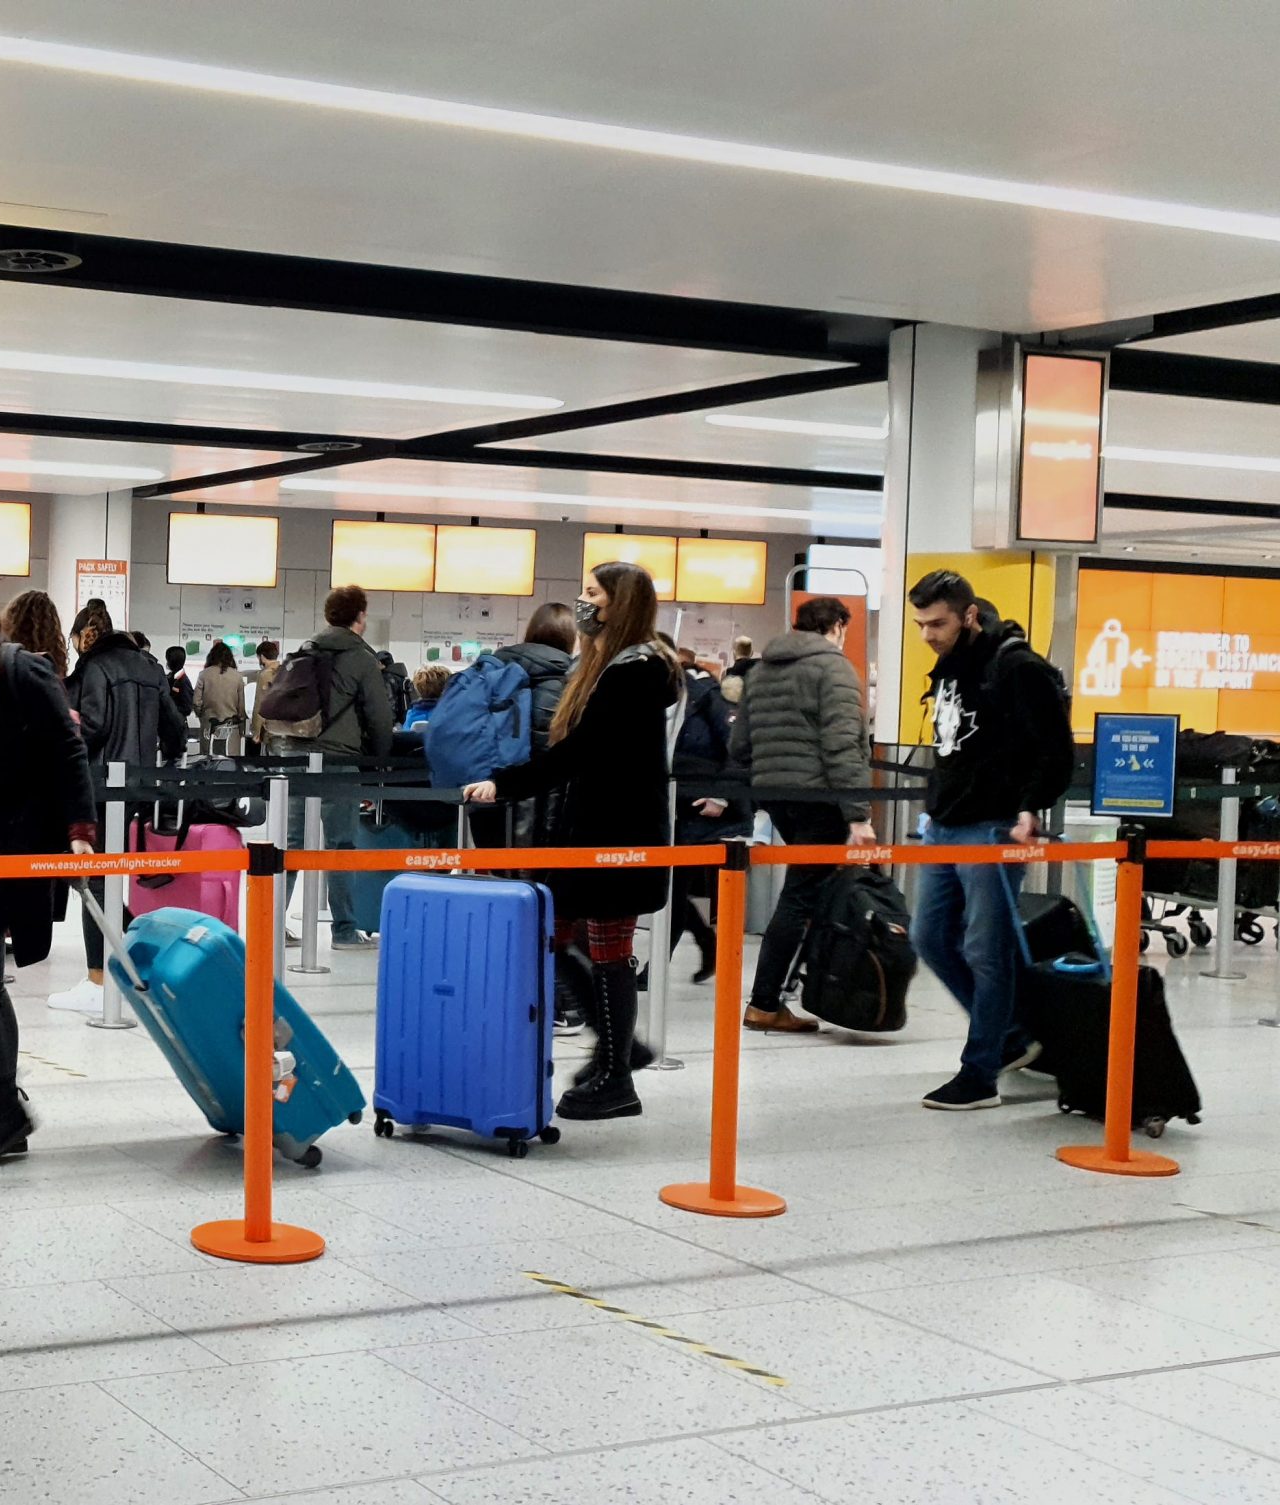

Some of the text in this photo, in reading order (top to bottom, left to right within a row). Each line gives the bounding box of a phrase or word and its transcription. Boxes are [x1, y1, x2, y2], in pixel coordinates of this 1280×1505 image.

[405, 852, 461, 868] easyJet
[595, 850, 647, 866] easyJet
[846, 847, 893, 861] easyJet
[1002, 846, 1045, 860] easyJet
[30, 857, 182, 871] www.easyJet.com/flight-tracker
